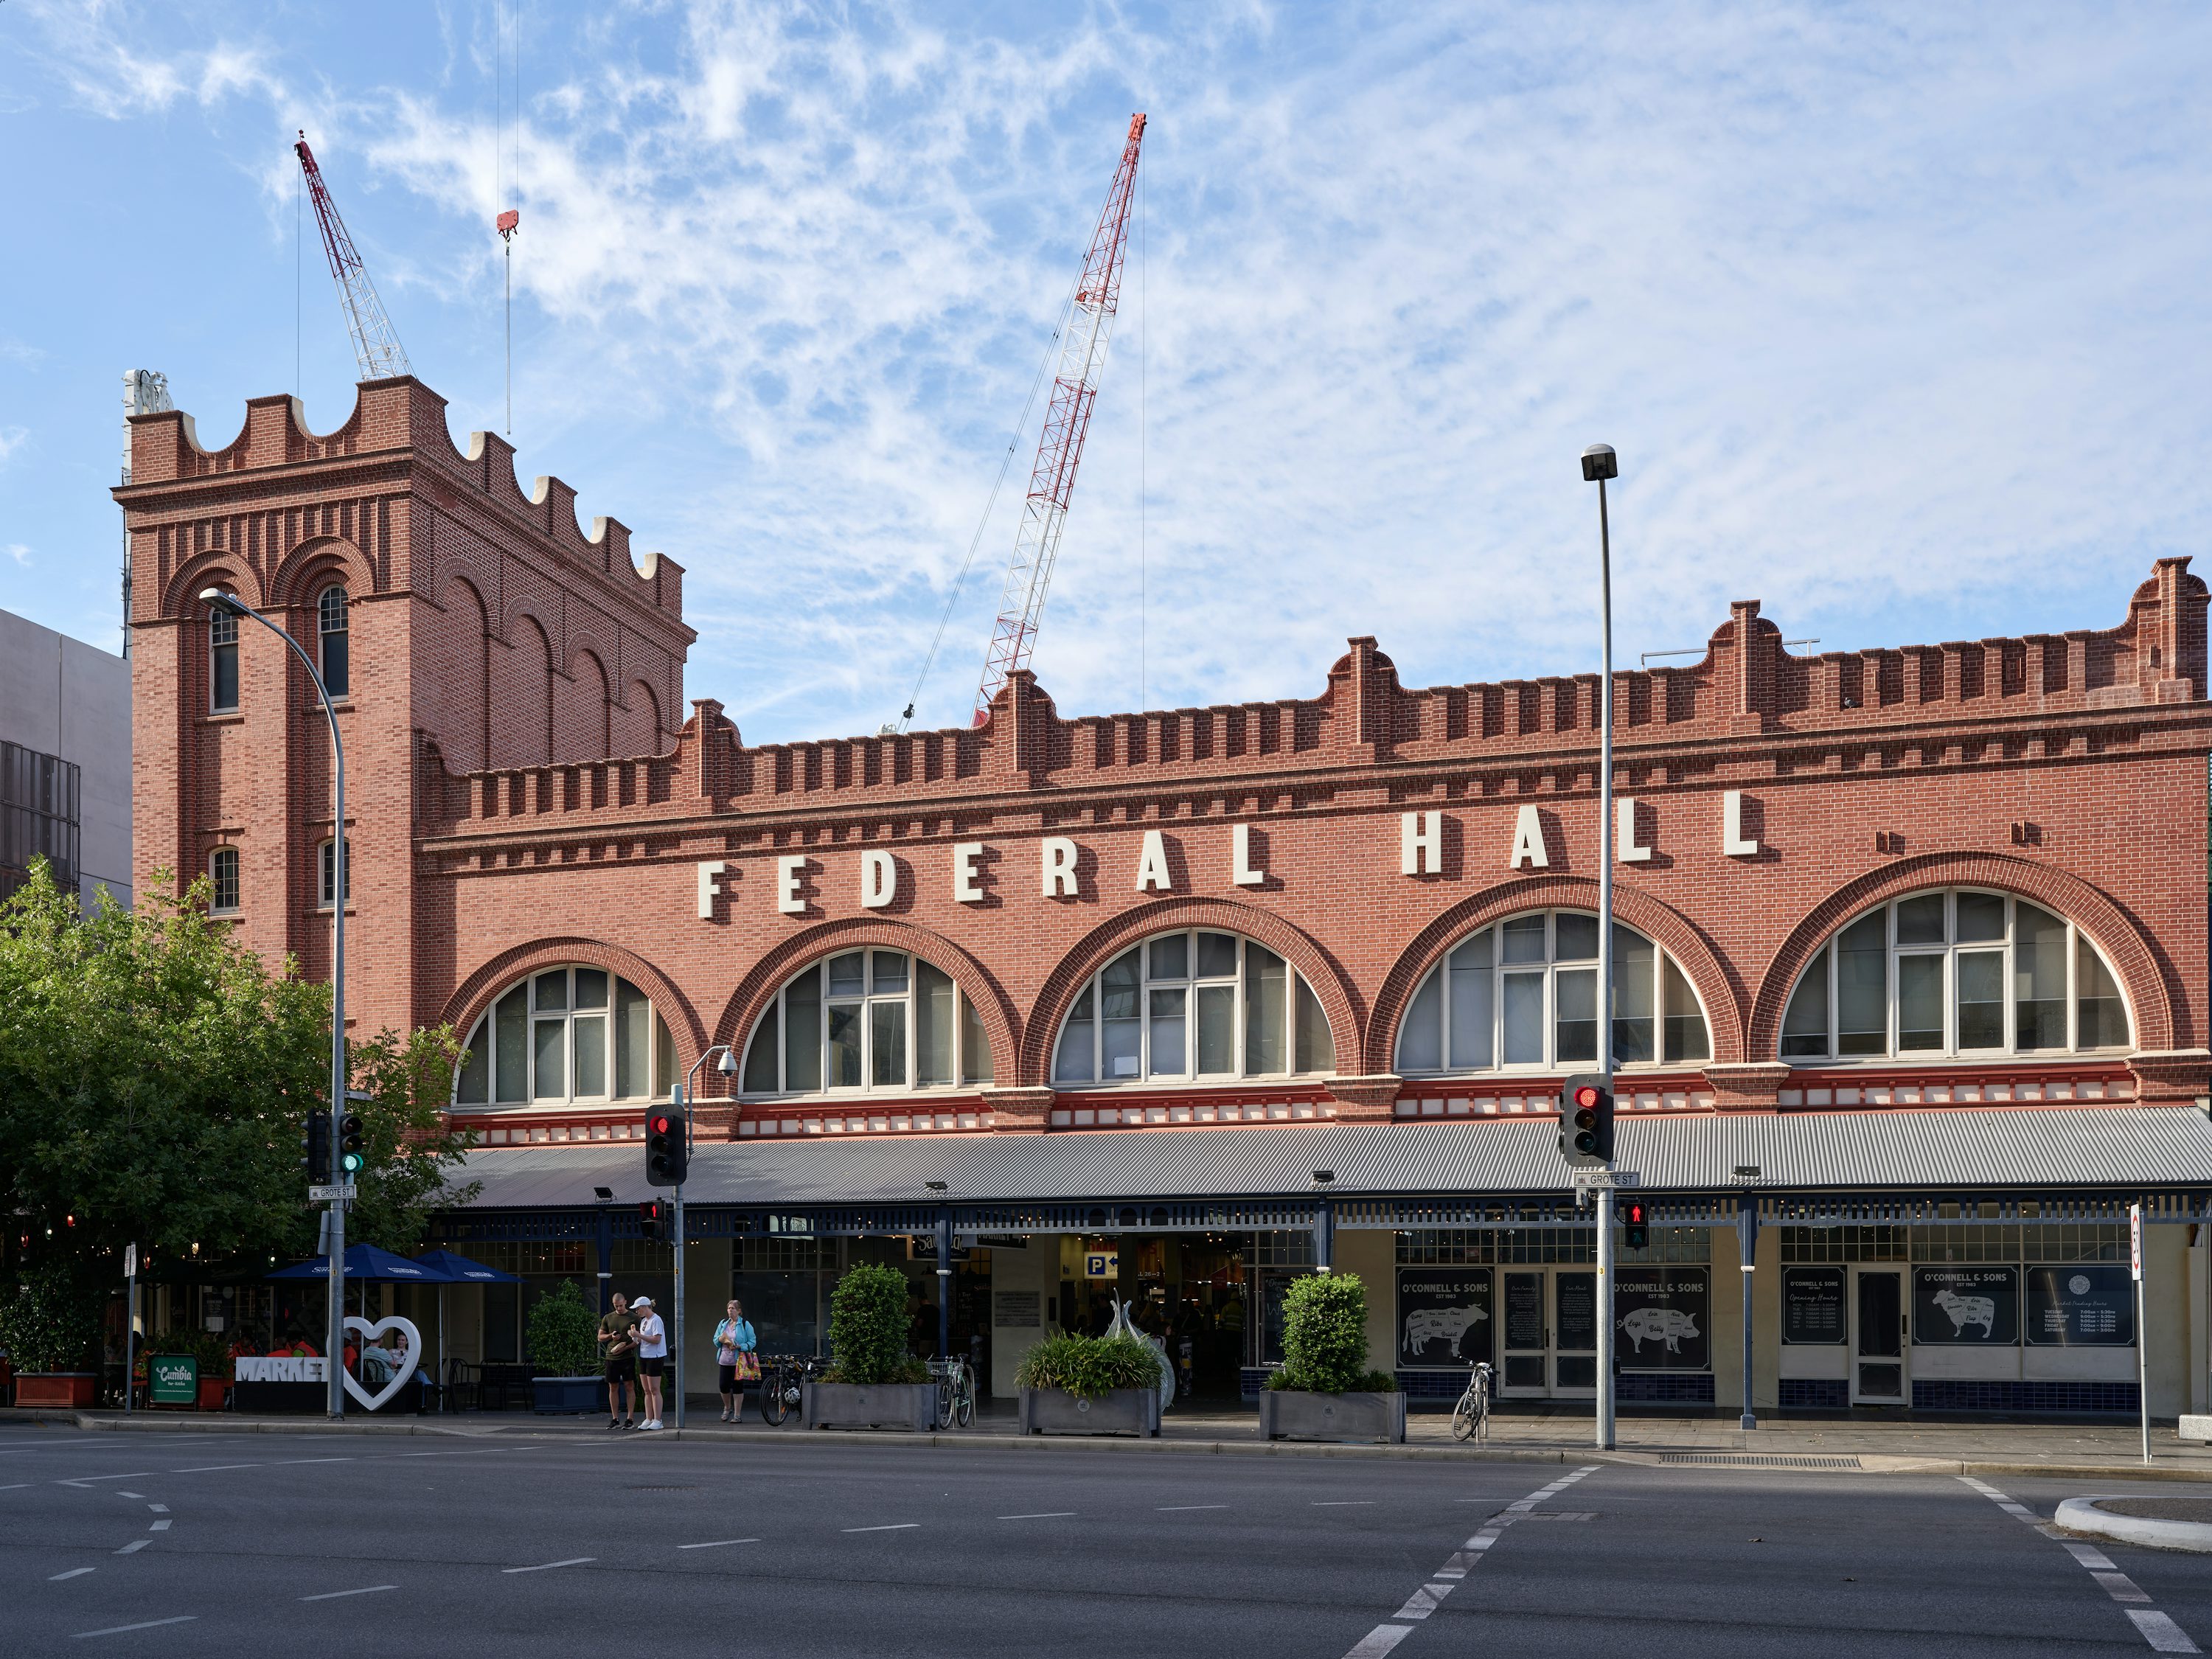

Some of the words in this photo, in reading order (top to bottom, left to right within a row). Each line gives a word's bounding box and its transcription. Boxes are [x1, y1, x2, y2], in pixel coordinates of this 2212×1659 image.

[698, 824, 1264, 919] FEDERAL
[1401, 790, 1759, 875] HALL
[1590, 1175, 1620, 1184] GROTE
[1622, 1175, 1633, 1184] ST
[321, 1188, 341, 1197] GROTE
[342, 1188, 350, 1196] ST
[1092, 1259, 1102, 1273] P
[1924, 1273, 1972, 1281] O'CONNELL
[1973, 1273, 1980, 1281] &
[1983, 1273, 2007, 1281] SONS
[1402, 1284, 1451, 1293] O'CONNELL
[1453, 1284, 1461, 1293] &
[1464, 1283, 1489, 1293] SONS
[1614, 1283, 1664, 1293] O'CONNELL
[1667, 1283, 1674, 1292] &
[1677, 1283, 1704, 1293] SONS
[1790, 1293, 1816, 1302] Opening
[1817, 1293, 1839, 1301] Hours
[1627, 1320, 1641, 1328] Legs
[1649, 1325, 1664, 1334] Belly
[156, 1366, 192, 1382] Cumbia
[236, 1357, 328, 1382] MARKET
